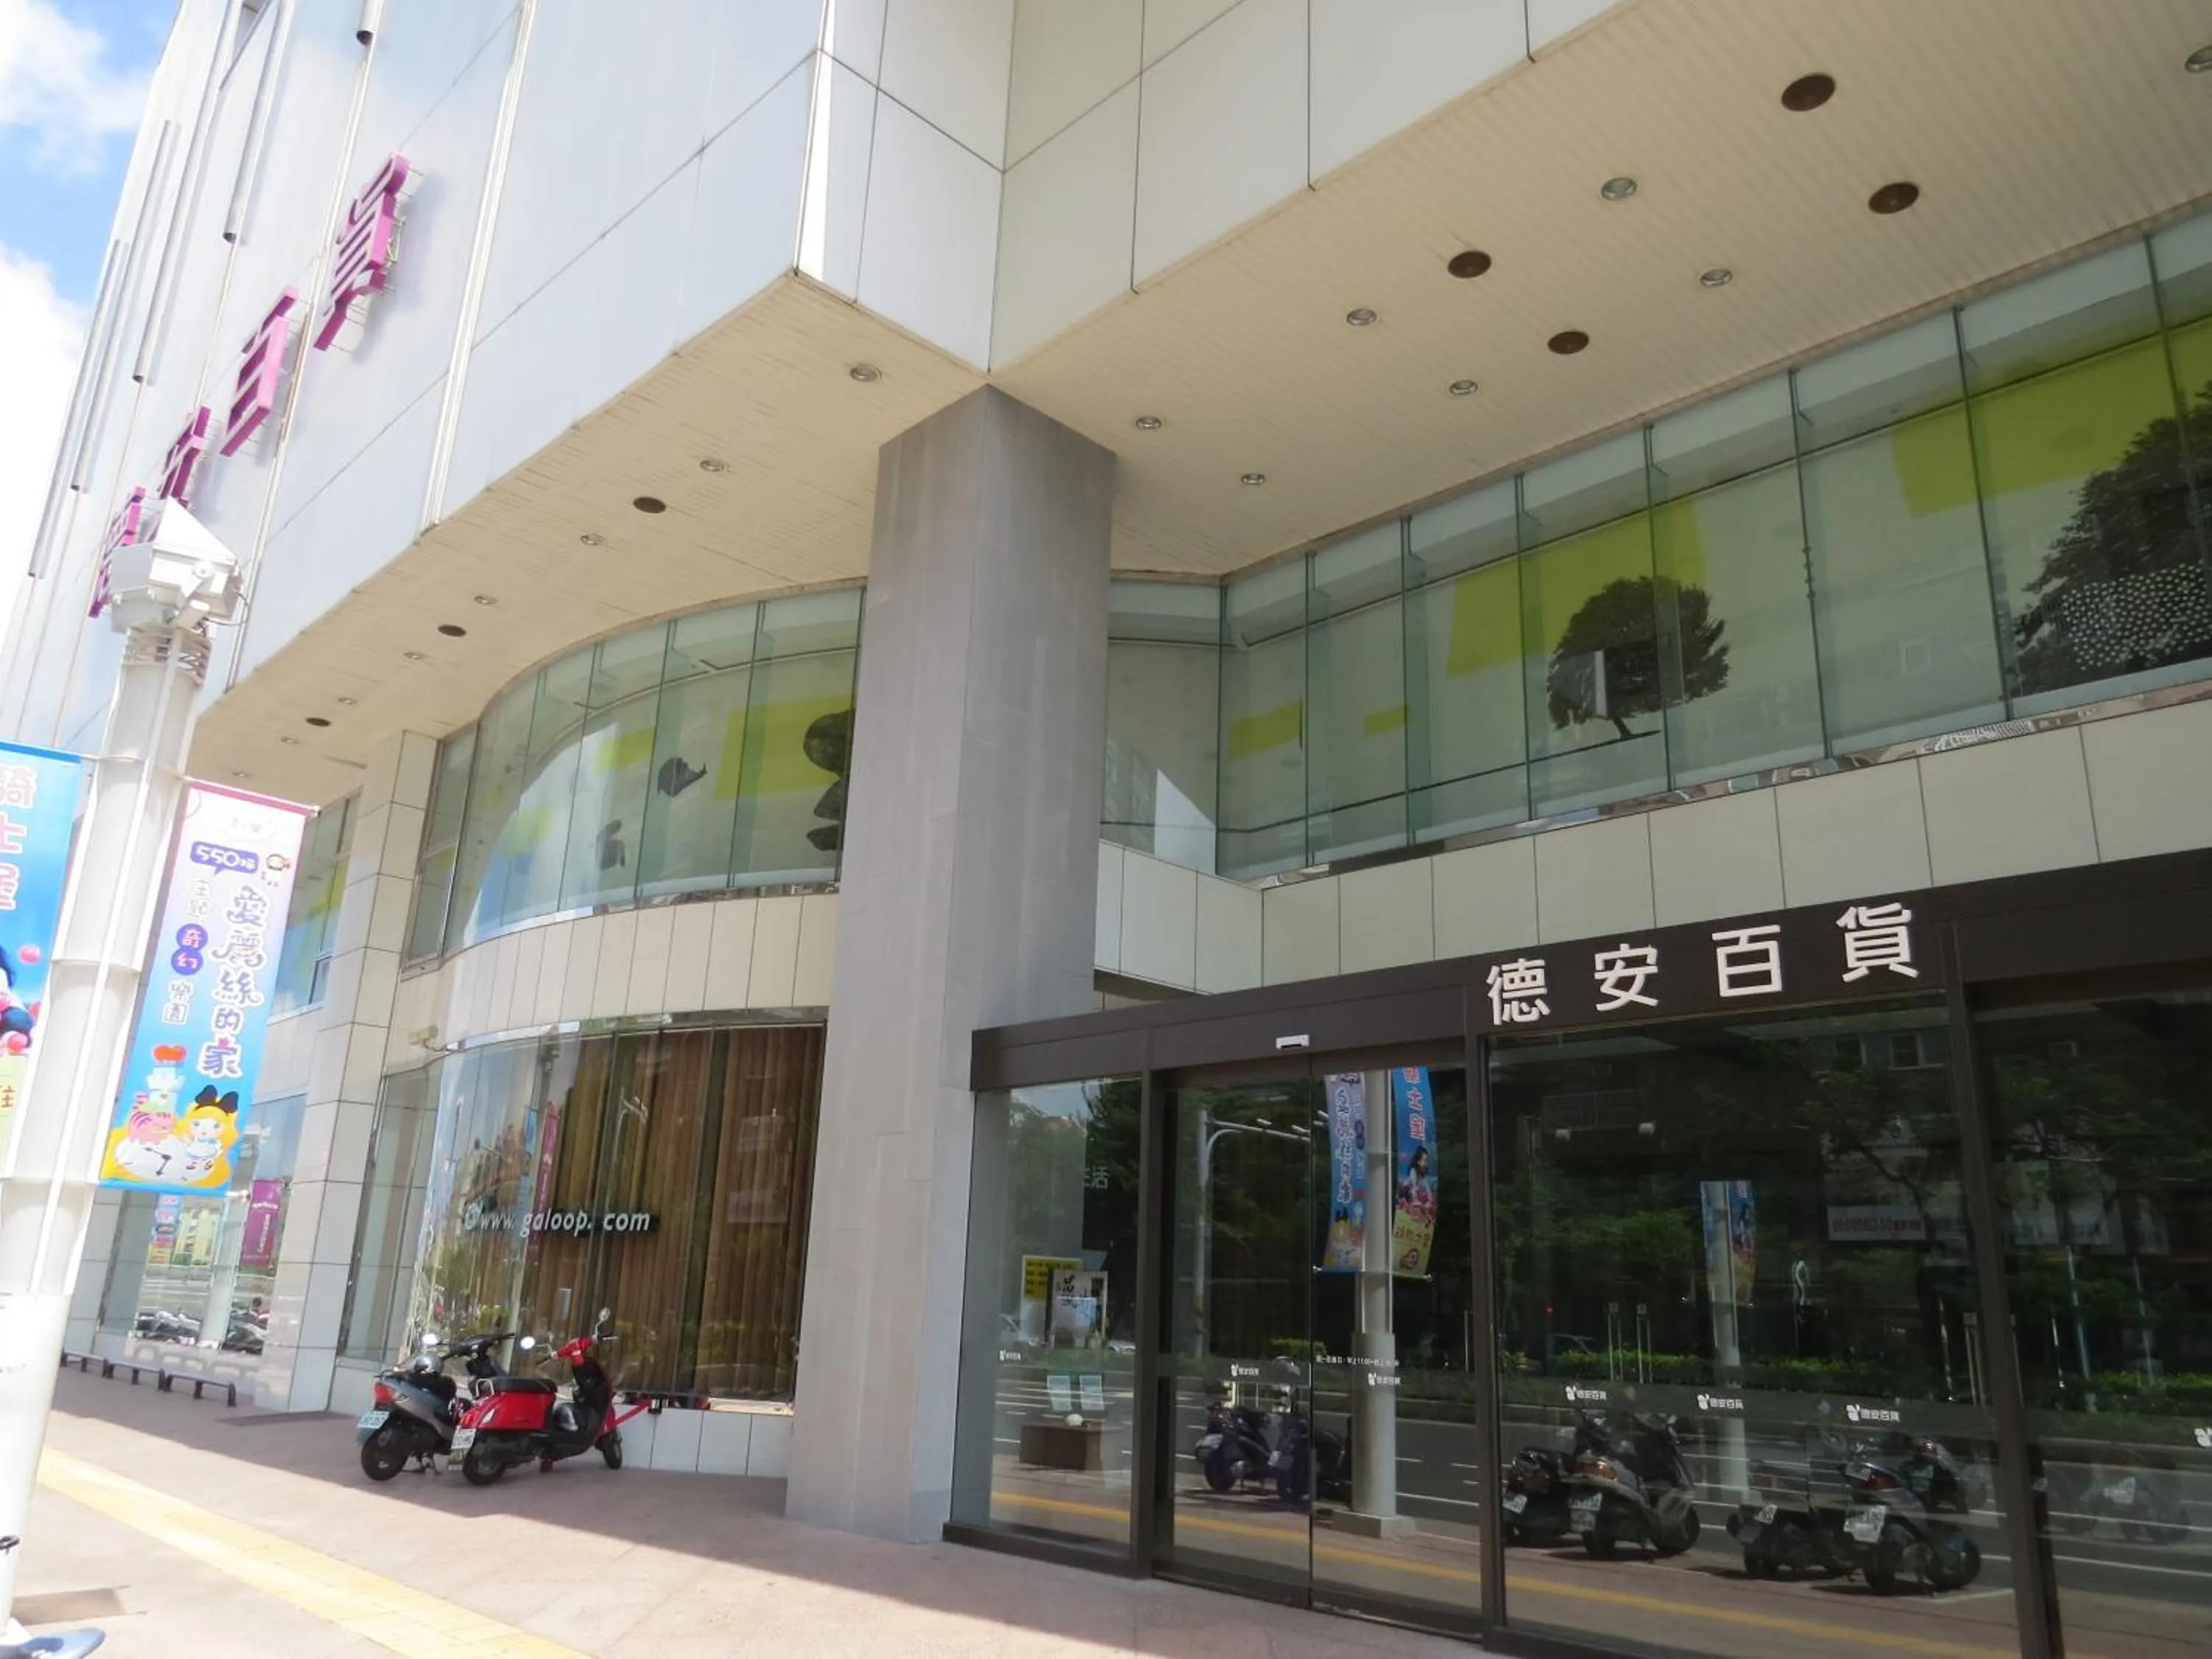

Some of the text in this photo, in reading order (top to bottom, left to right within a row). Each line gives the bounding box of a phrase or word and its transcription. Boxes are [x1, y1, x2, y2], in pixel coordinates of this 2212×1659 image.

[200, 884, 268, 1077] 愛麗絲的家
[1486, 902, 1920, 1026] 德安百貨
